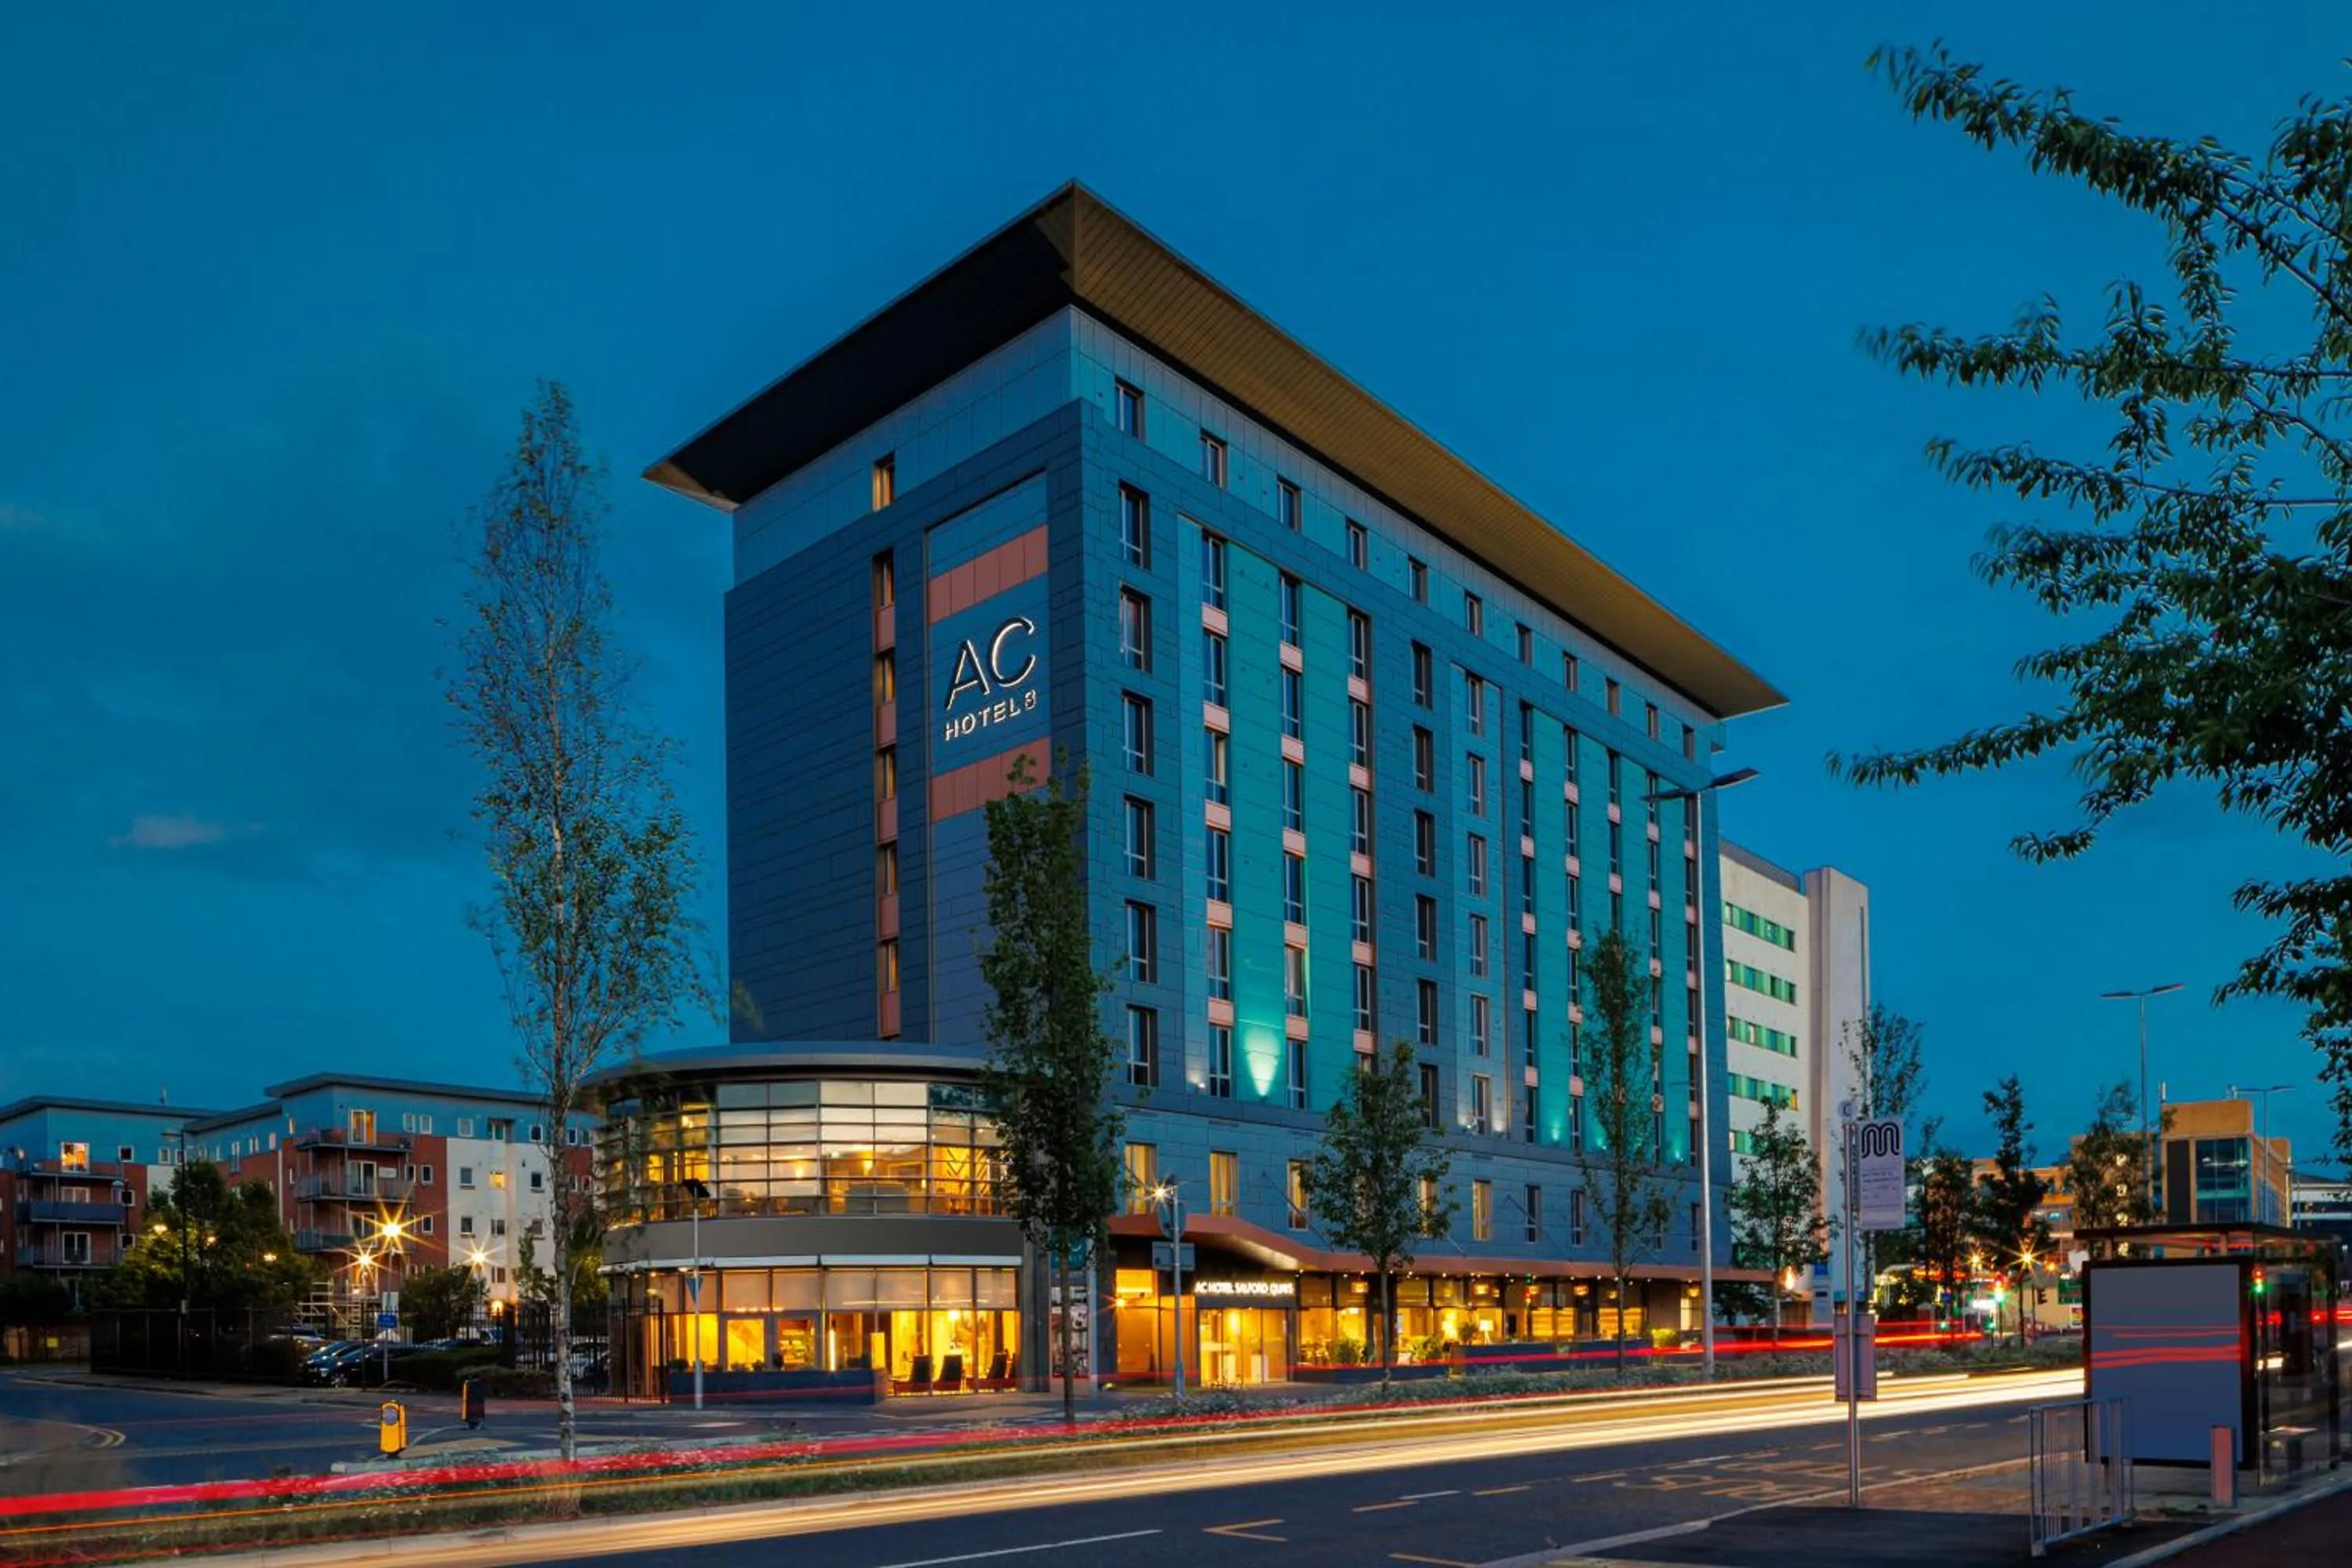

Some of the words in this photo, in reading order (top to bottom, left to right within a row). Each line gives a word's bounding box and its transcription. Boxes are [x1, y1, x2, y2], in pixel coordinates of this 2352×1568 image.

[946, 616, 1036, 710] AC
[945, 690, 1036, 741] HOTELS
[1195, 1282, 1207, 1293] AC
[1208, 1282, 1234, 1294] HOTEL
